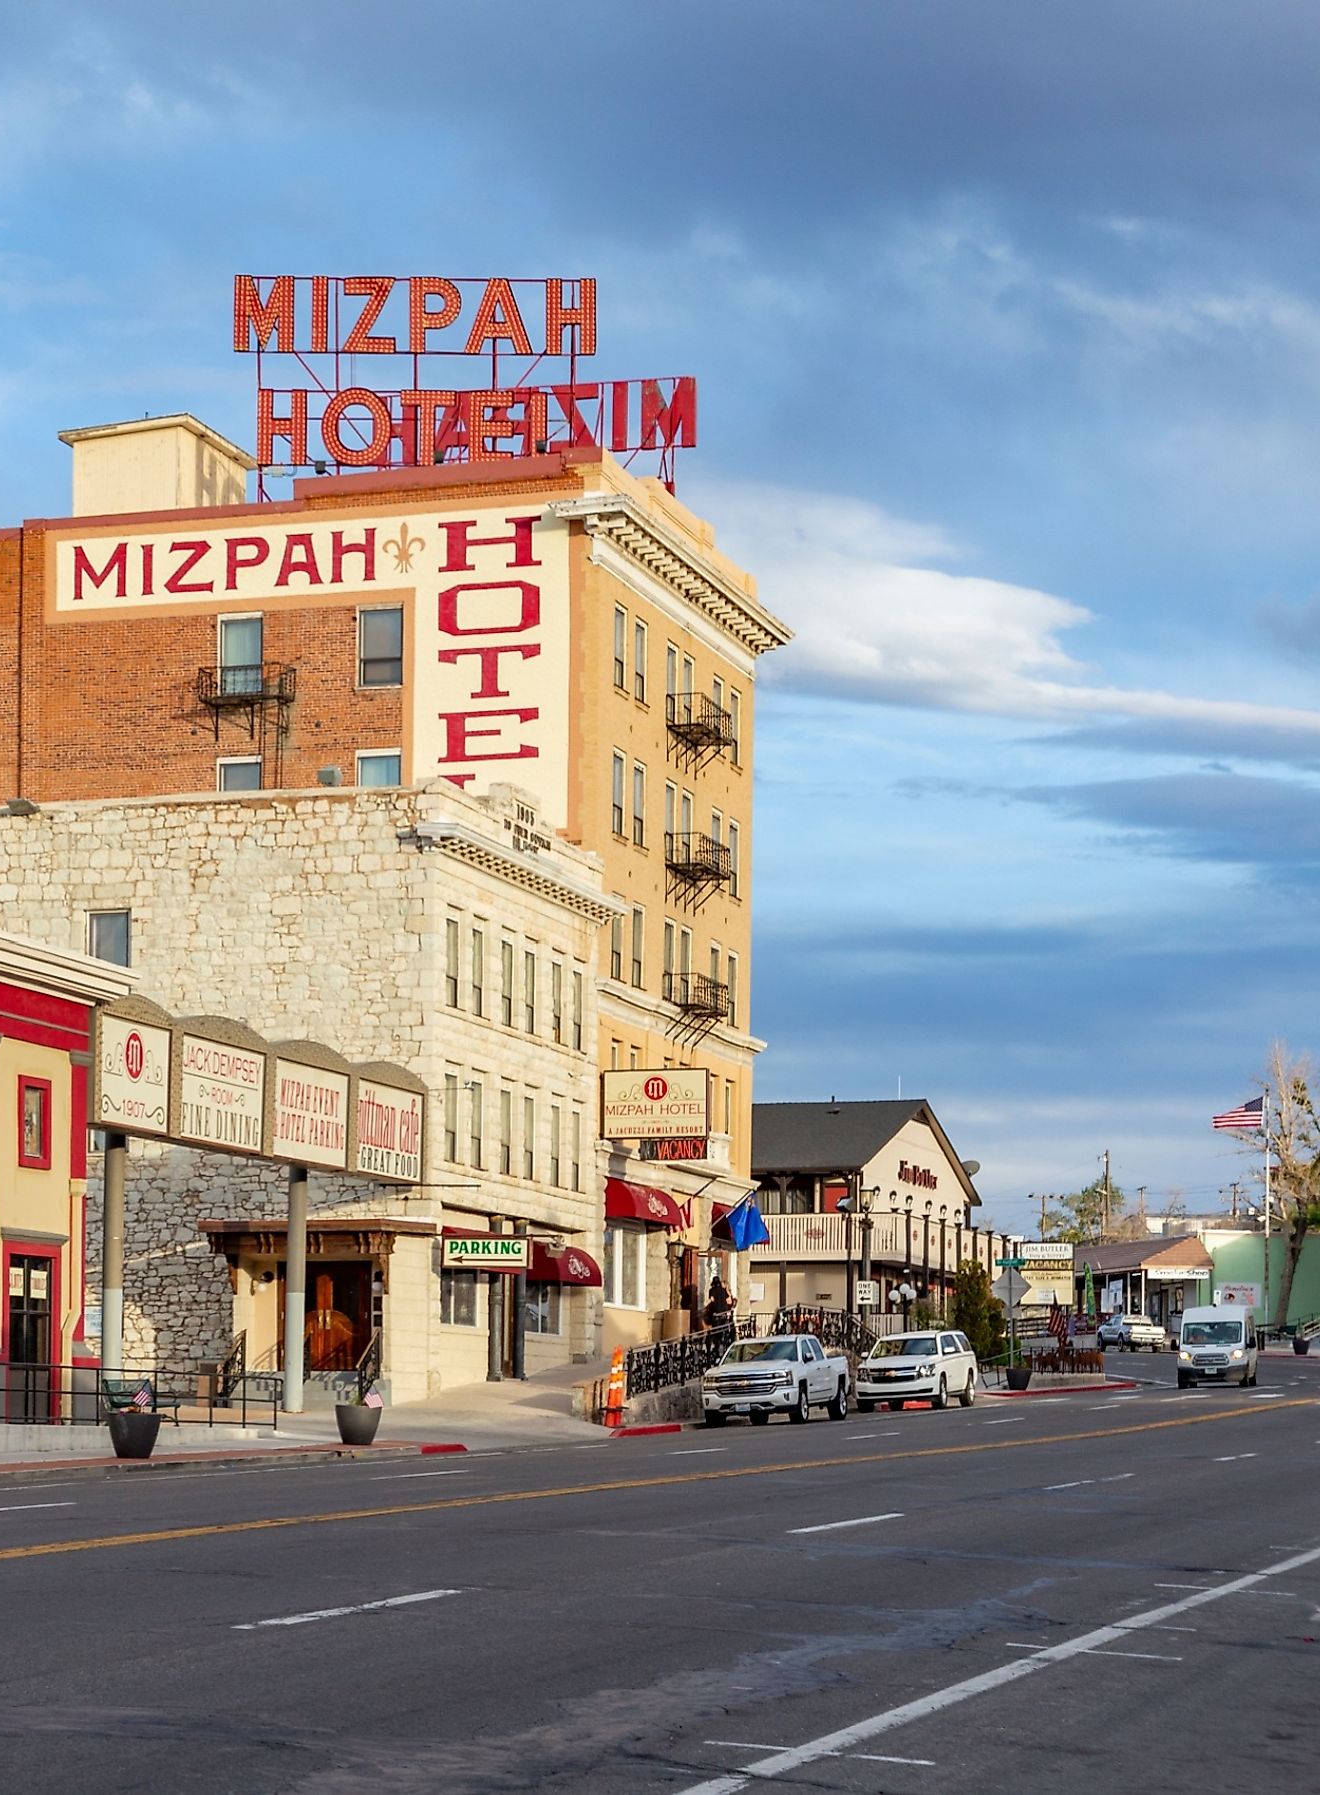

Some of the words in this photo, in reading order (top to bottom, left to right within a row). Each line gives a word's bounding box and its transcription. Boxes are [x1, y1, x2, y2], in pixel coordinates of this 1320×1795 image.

[233, 274, 596, 355] MIZPAH
[257, 387, 548, 466] HOTEL
[73, 527, 378, 600] MIZPAH
[438, 515, 542, 789] HOTE
[517, 803, 535, 827] 1905
[183, 1045, 212, 1073] JACK
[213, 1051, 261, 1085] DEMPSEY
[122, 1099, 146, 1119] 1907
[211, 1086, 234, 1107] ROOM
[281, 1078, 311, 1112] MIZPAH
[313, 1086, 340, 1118] EVENT
[605, 1104, 654, 1116] MIZPAH
[659, 1103, 705, 1115] HOTEL
[181, 1102, 211, 1138] FINE
[216, 1109, 260, 1147] DINING
[280, 1111, 306, 1144] HOTEL
[309, 1117, 344, 1150] PARKING
[647, 1126, 672, 1135] FAMILY
[361, 1146, 392, 1174] GREAT
[394, 1153, 418, 1178] FOOD
[656, 1140, 706, 1160] VACANCY
[449, 1241, 522, 1254] PARKING
